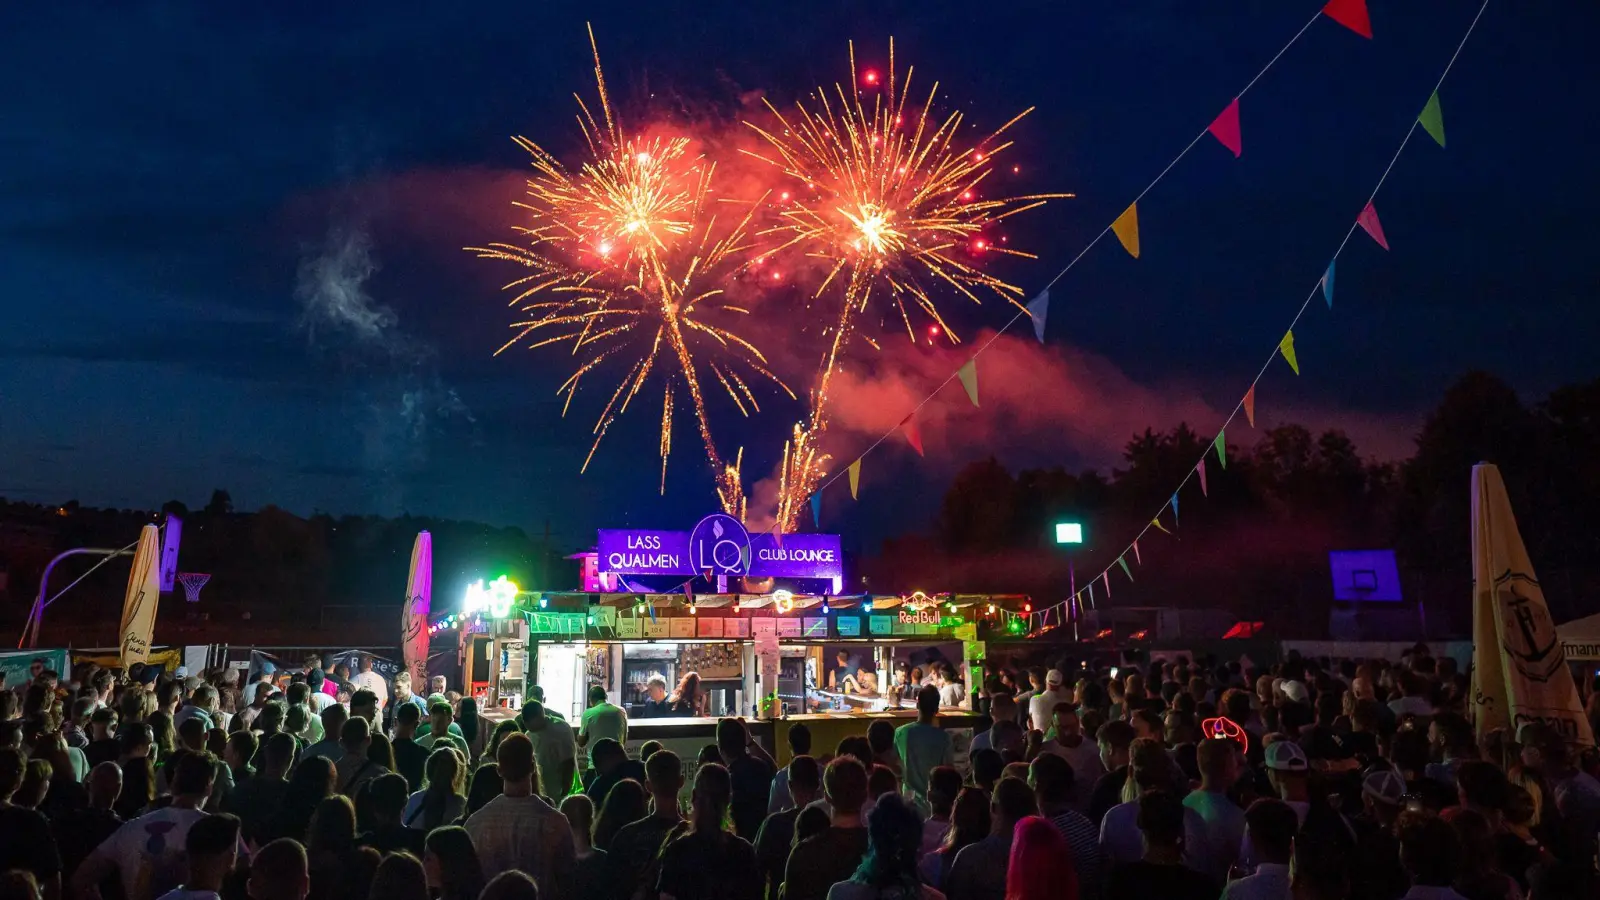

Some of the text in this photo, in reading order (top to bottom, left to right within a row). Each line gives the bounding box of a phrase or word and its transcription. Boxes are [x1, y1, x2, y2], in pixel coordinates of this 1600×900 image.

[627, 535, 661, 550] LASS
[608, 552, 679, 569] QUALMEN
[699, 539, 742, 574] LQ
[758, 548, 835, 562] CLUB LOUNGE
[899, 610, 941, 624] Red Bull
